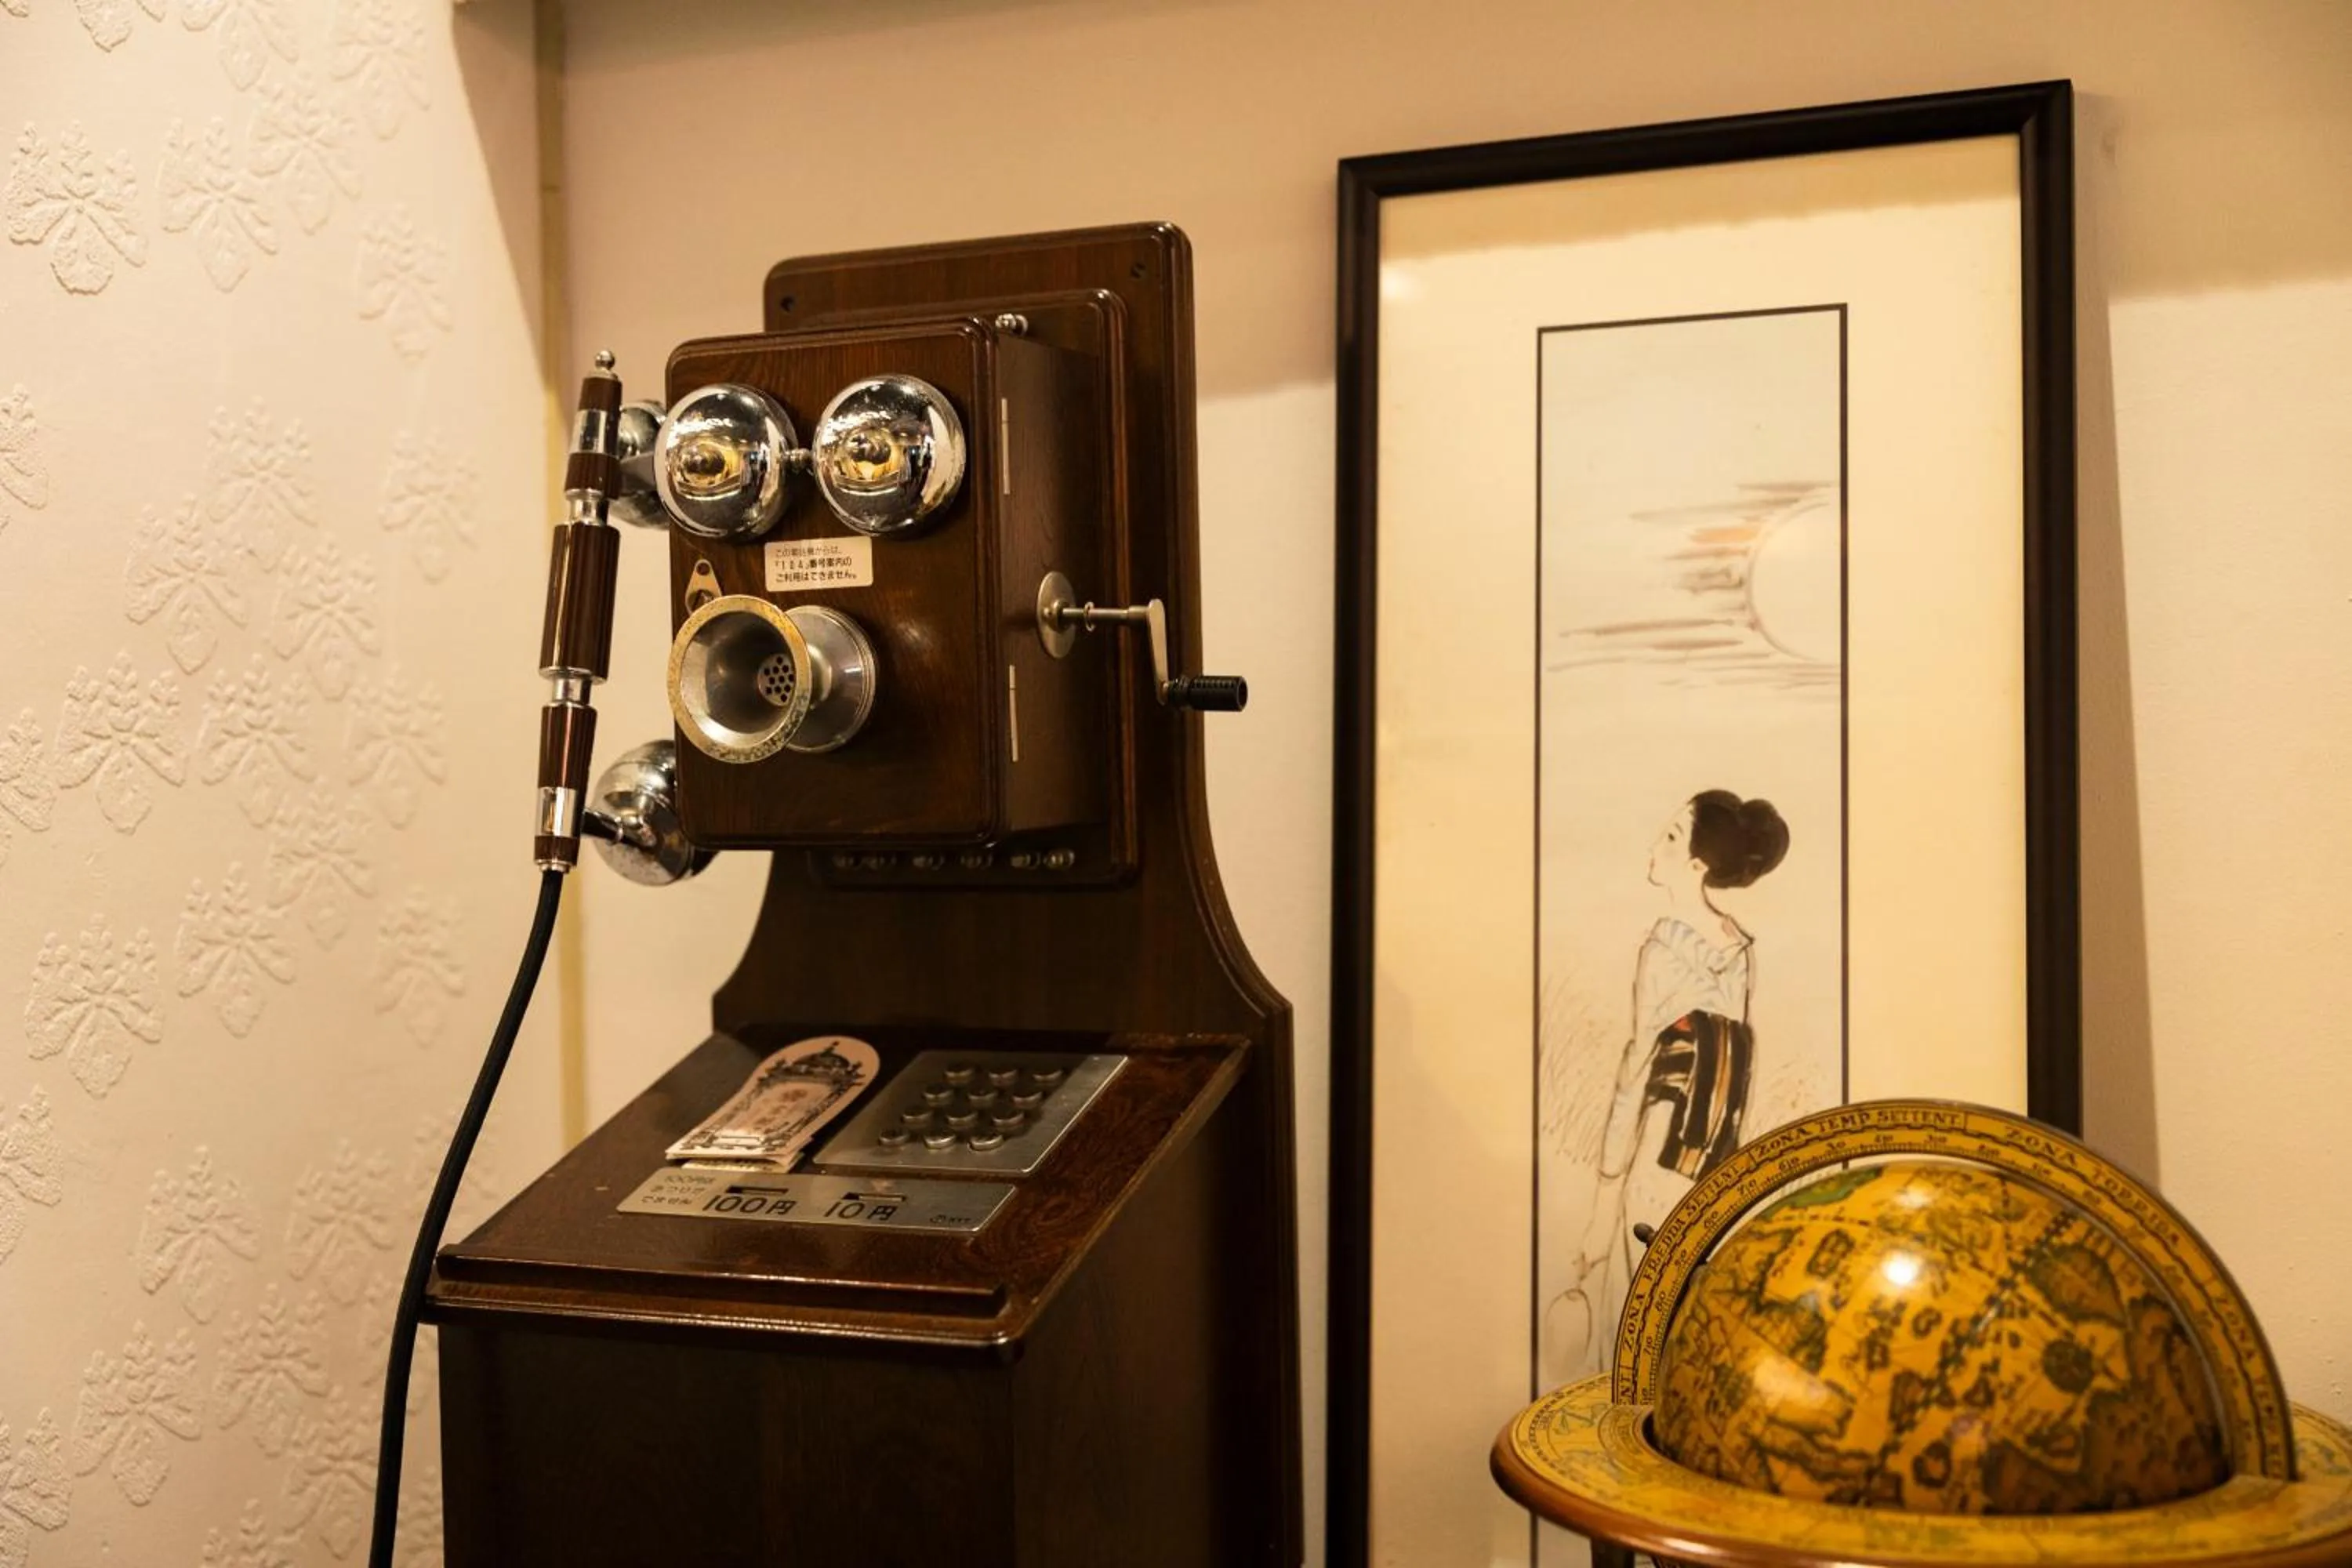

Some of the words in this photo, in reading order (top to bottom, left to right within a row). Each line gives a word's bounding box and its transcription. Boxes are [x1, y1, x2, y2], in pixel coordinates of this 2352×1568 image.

[1754, 1125, 1810, 1156] ZONA
[2004, 1127, 2080, 1167] ZONA
[702, 1194, 797, 1215] 100円
[1623, 1291, 1646, 1351] ZONA
[1643, 1217, 1686, 1282] FREDDA
